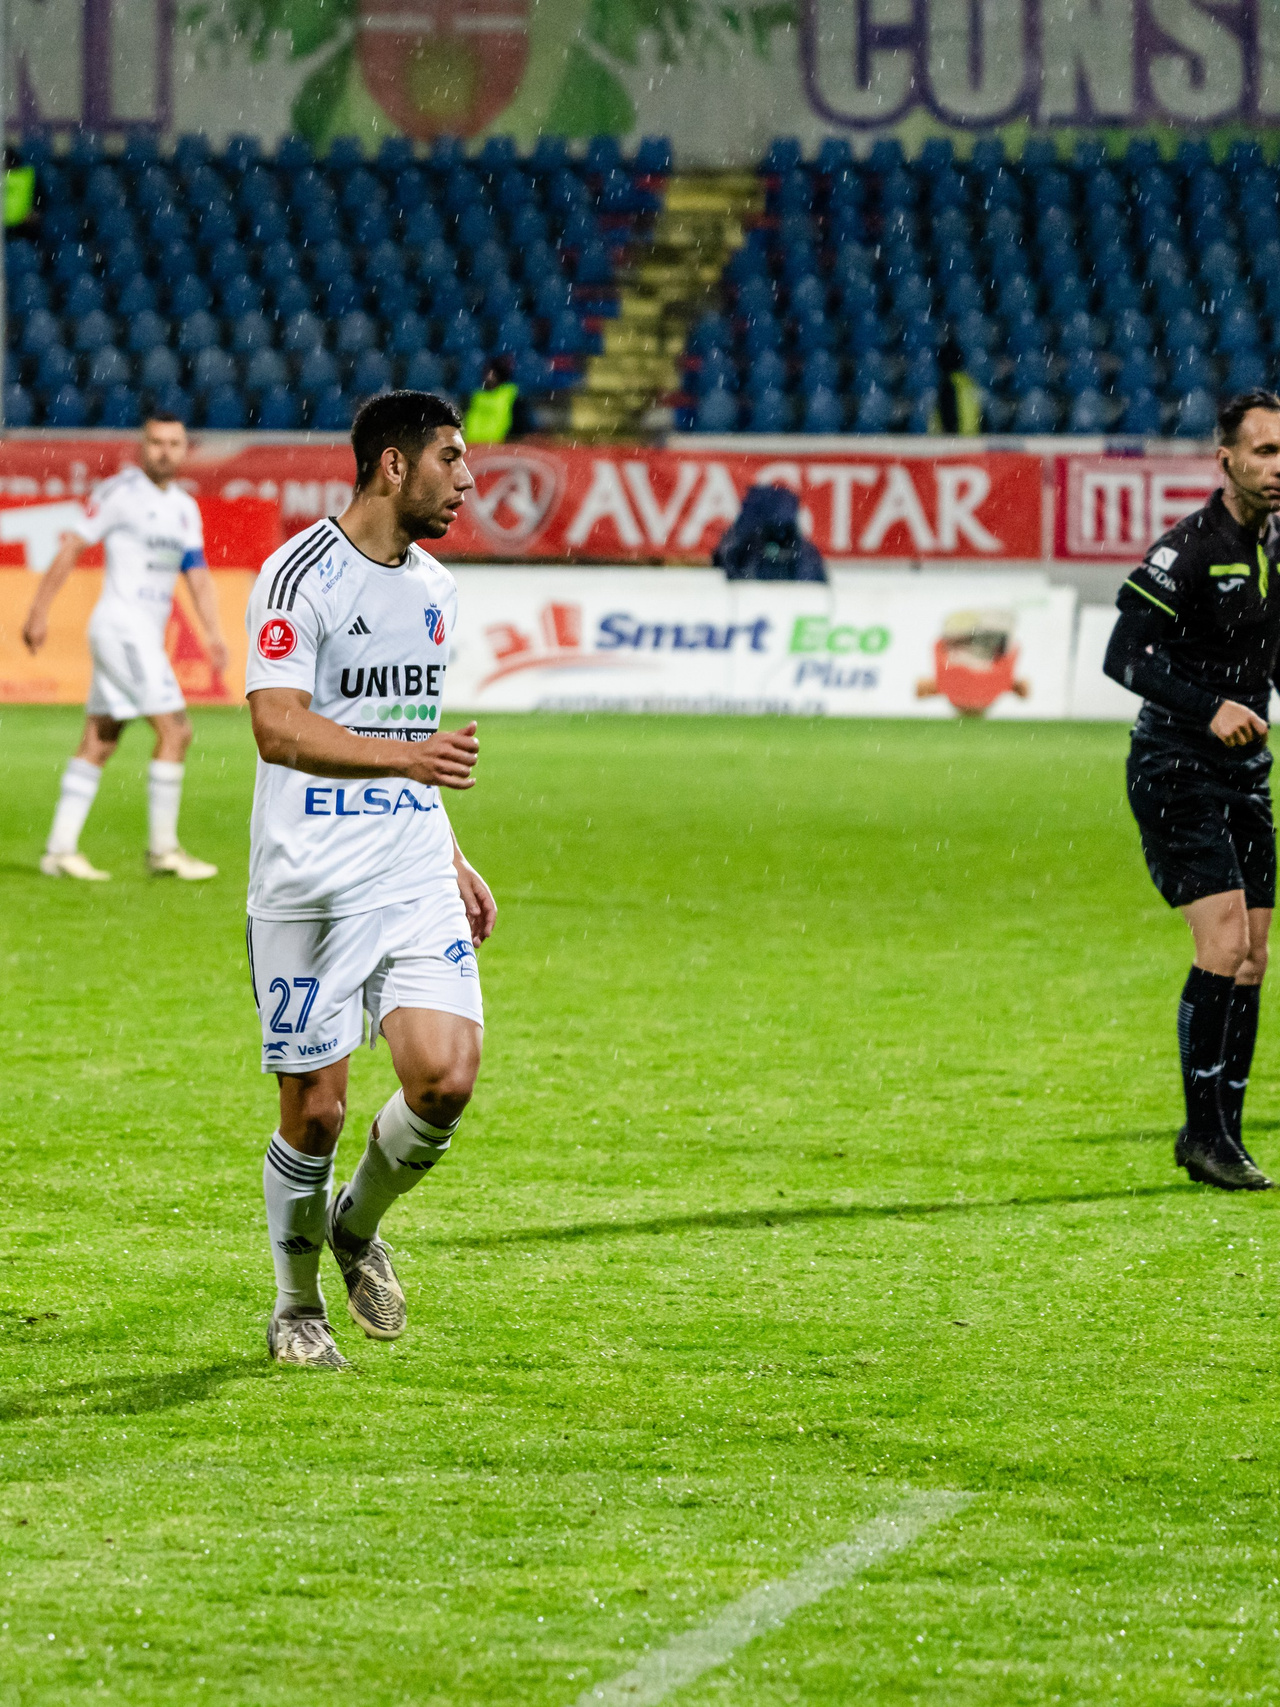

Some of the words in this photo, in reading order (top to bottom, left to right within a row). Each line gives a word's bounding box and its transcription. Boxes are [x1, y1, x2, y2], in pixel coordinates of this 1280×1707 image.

[597, 611, 770, 655] Smart
[788, 614, 892, 656] Eco
[340, 664, 447, 699] UNIBE
[793, 659, 881, 691] Plus
[269, 976, 320, 1034] 27
[297, 1038, 338, 1056] Vestra
